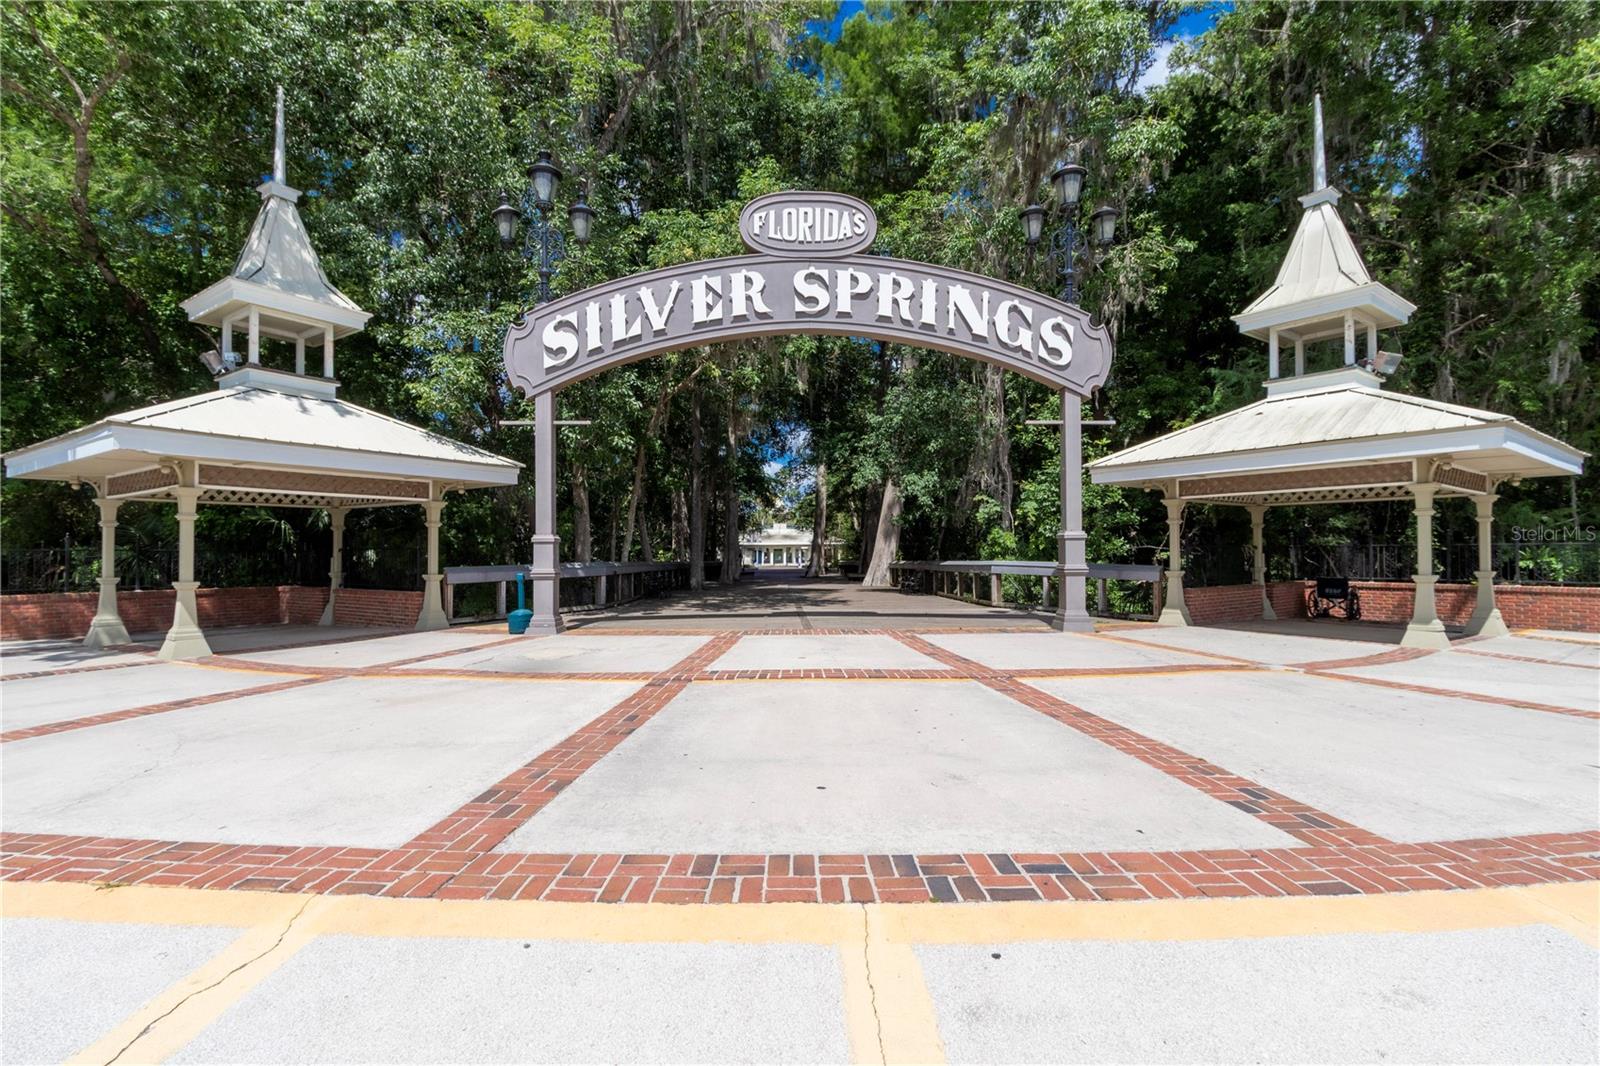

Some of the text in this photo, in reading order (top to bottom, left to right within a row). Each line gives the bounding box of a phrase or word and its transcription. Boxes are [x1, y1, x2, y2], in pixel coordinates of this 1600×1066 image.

[753, 207, 866, 242] FLORIDA'S
[542, 267, 1075, 370] SILVER SPRINGS
